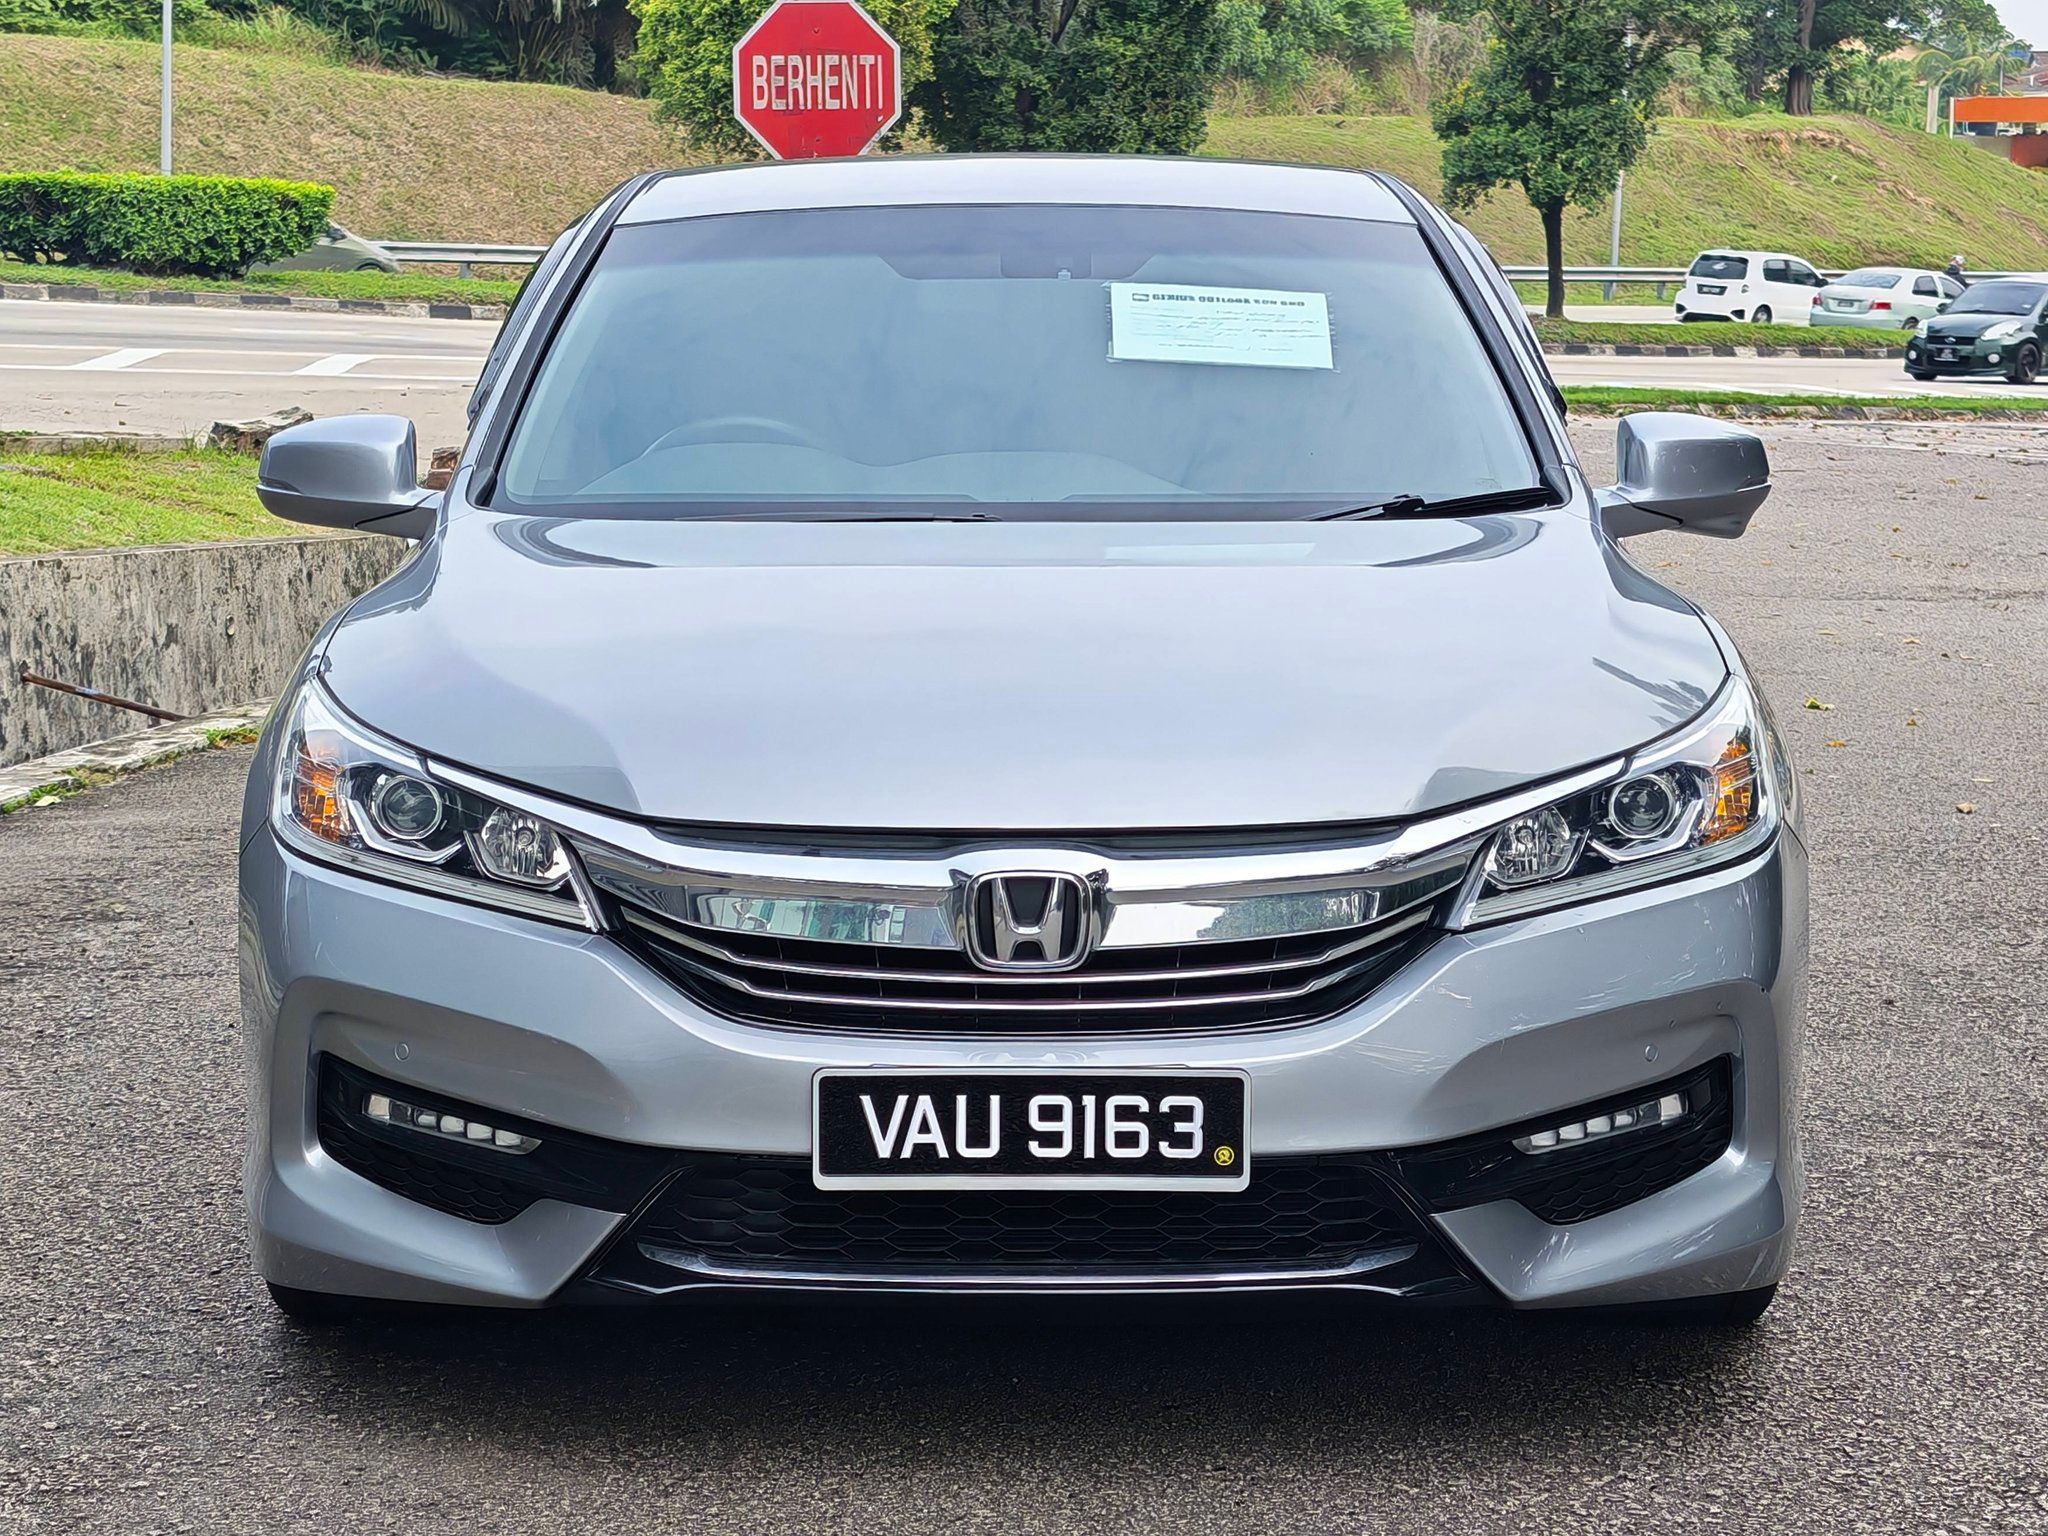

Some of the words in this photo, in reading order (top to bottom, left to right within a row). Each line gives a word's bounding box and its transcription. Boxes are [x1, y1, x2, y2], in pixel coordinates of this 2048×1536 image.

[752, 54, 883, 111] BERHENTI
[859, 1094, 1001, 1160] VAU
[1028, 1094, 1204, 1160] 9163
